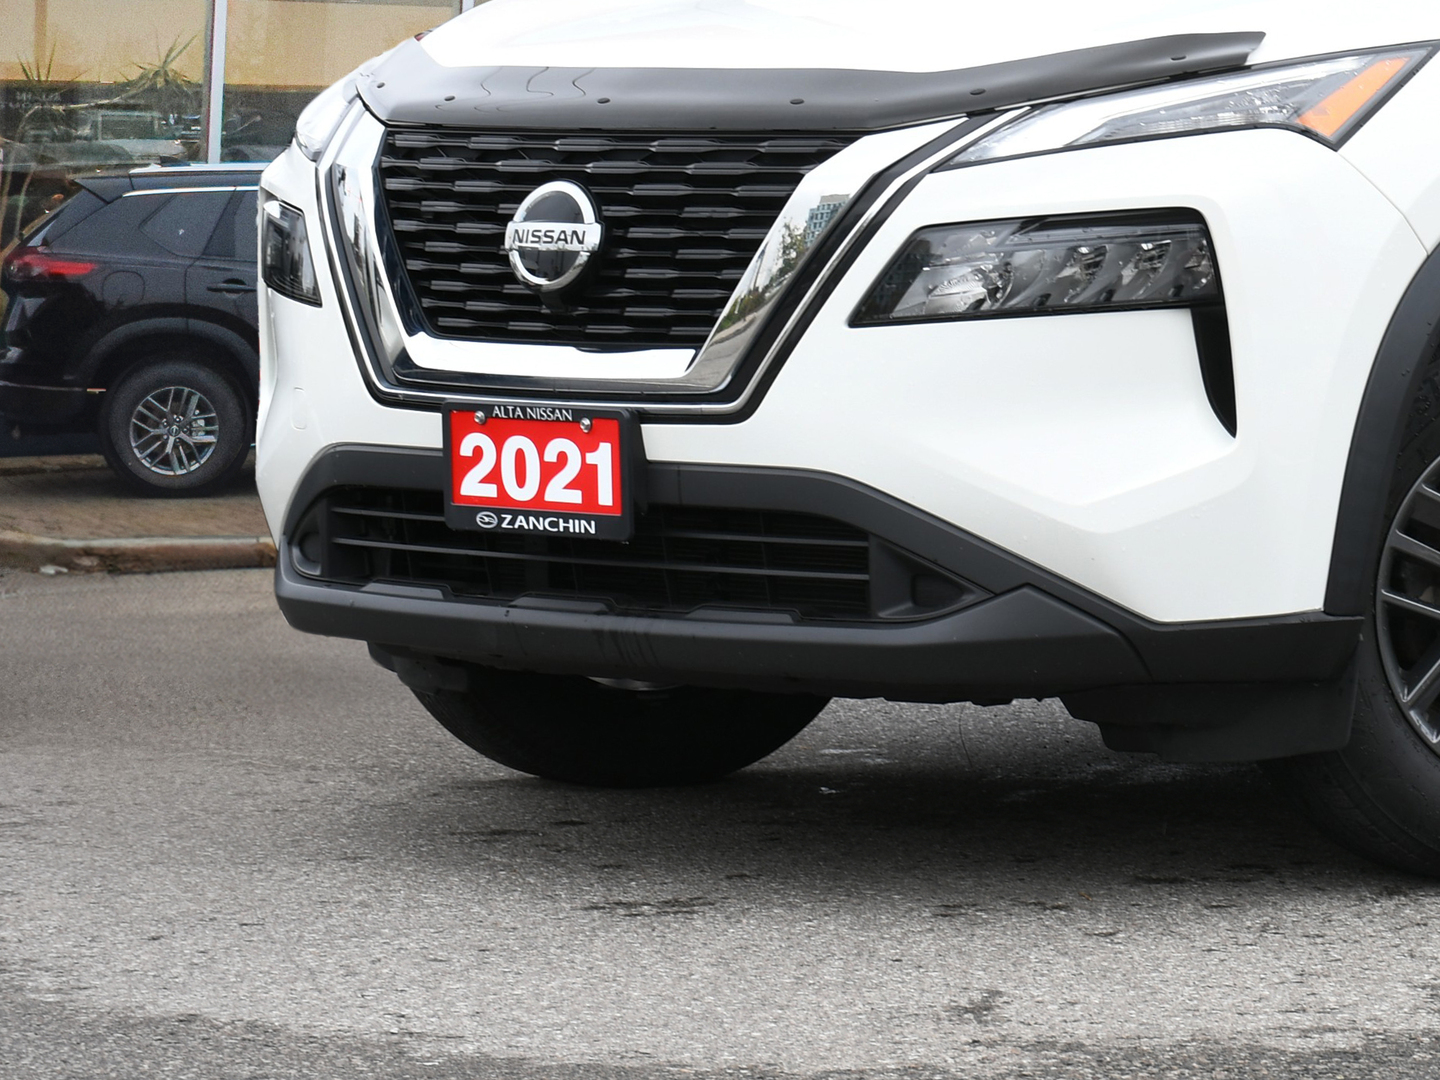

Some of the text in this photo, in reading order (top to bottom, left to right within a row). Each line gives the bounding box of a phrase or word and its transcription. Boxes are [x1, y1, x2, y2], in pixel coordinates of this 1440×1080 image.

[512, 228, 587, 245] NISSAN
[492, 405, 573, 422] ALTA NISSAN
[459, 432, 614, 506] 2021
[501, 514, 596, 534] ZANCHIN
